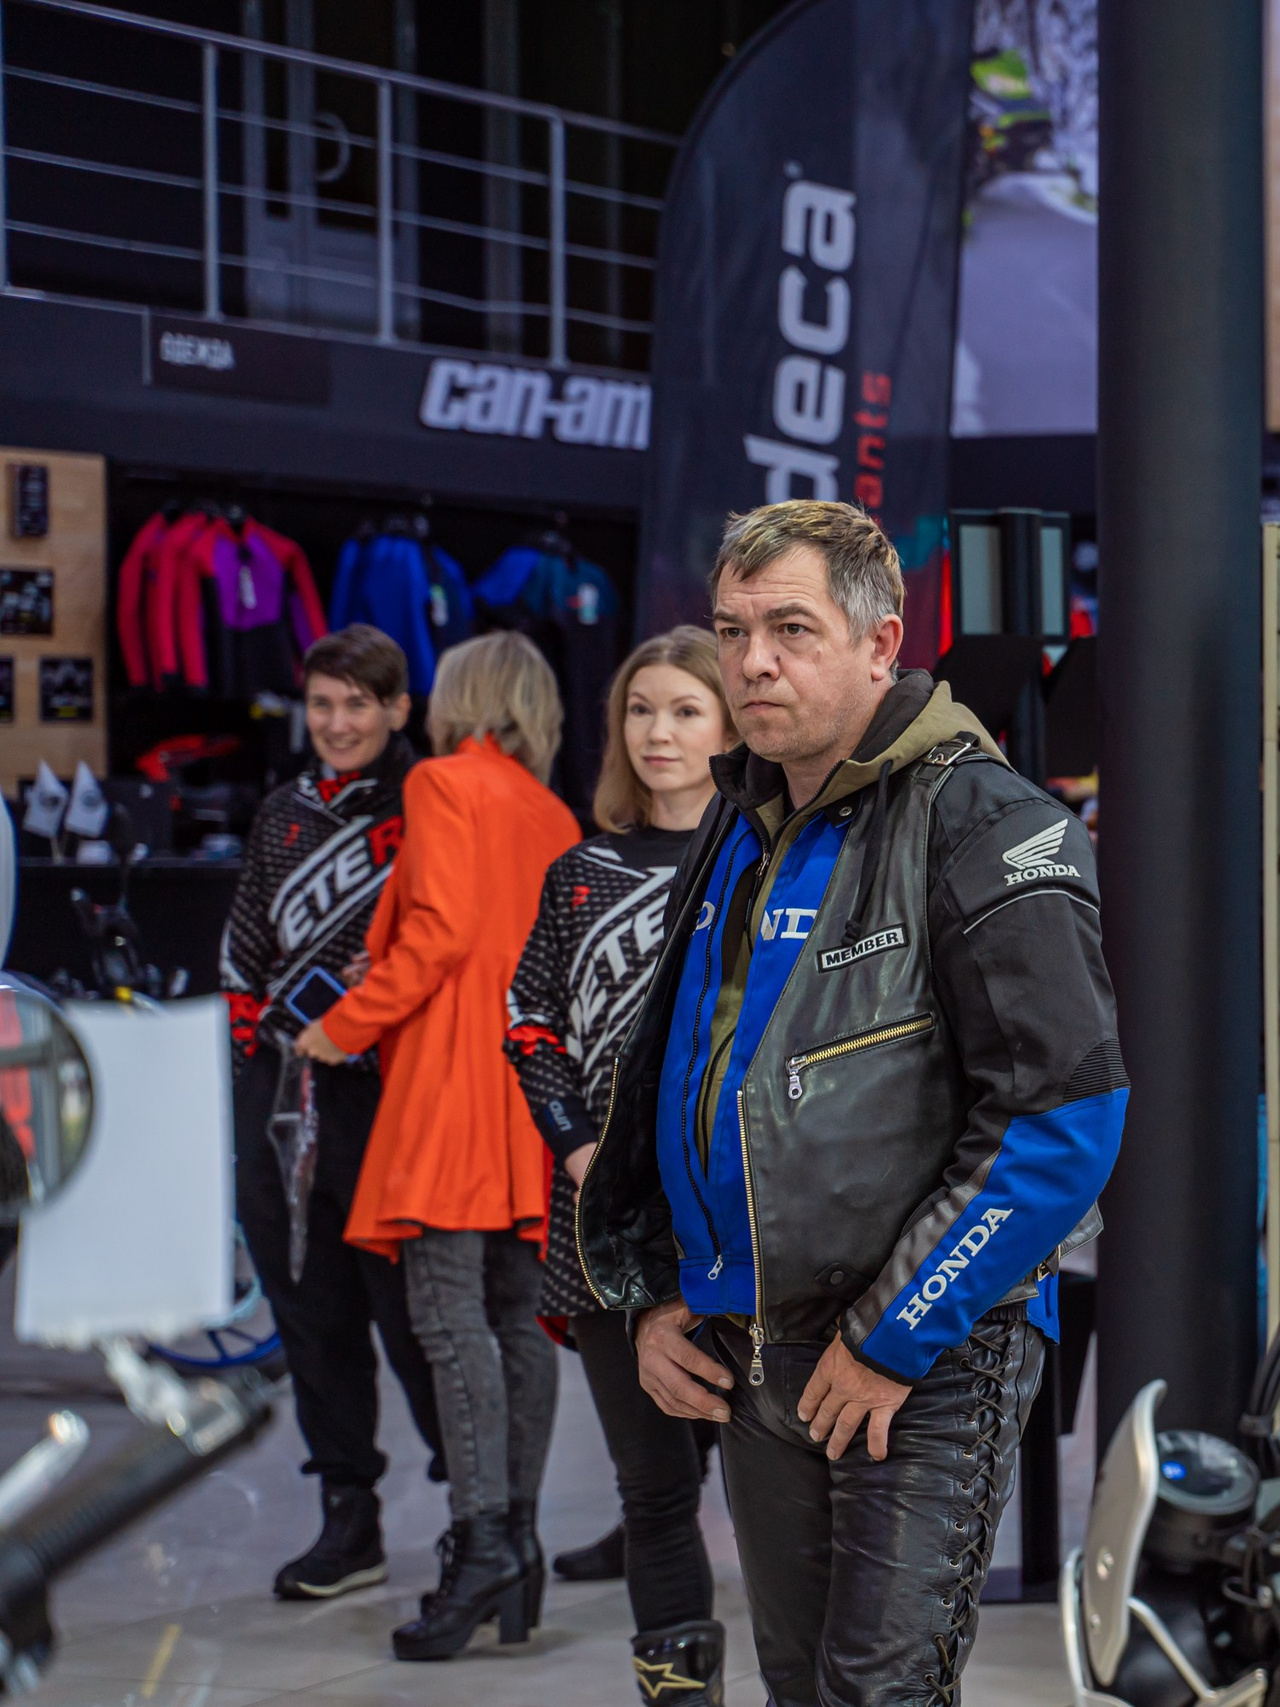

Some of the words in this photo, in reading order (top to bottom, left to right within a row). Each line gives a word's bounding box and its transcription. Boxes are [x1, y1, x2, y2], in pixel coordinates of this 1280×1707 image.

[853, 370, 892, 510] ants
[1004, 864, 1082, 887] HONDA
[825, 931, 901, 967] MEMBER
[896, 1207, 1014, 1331] HONDA
